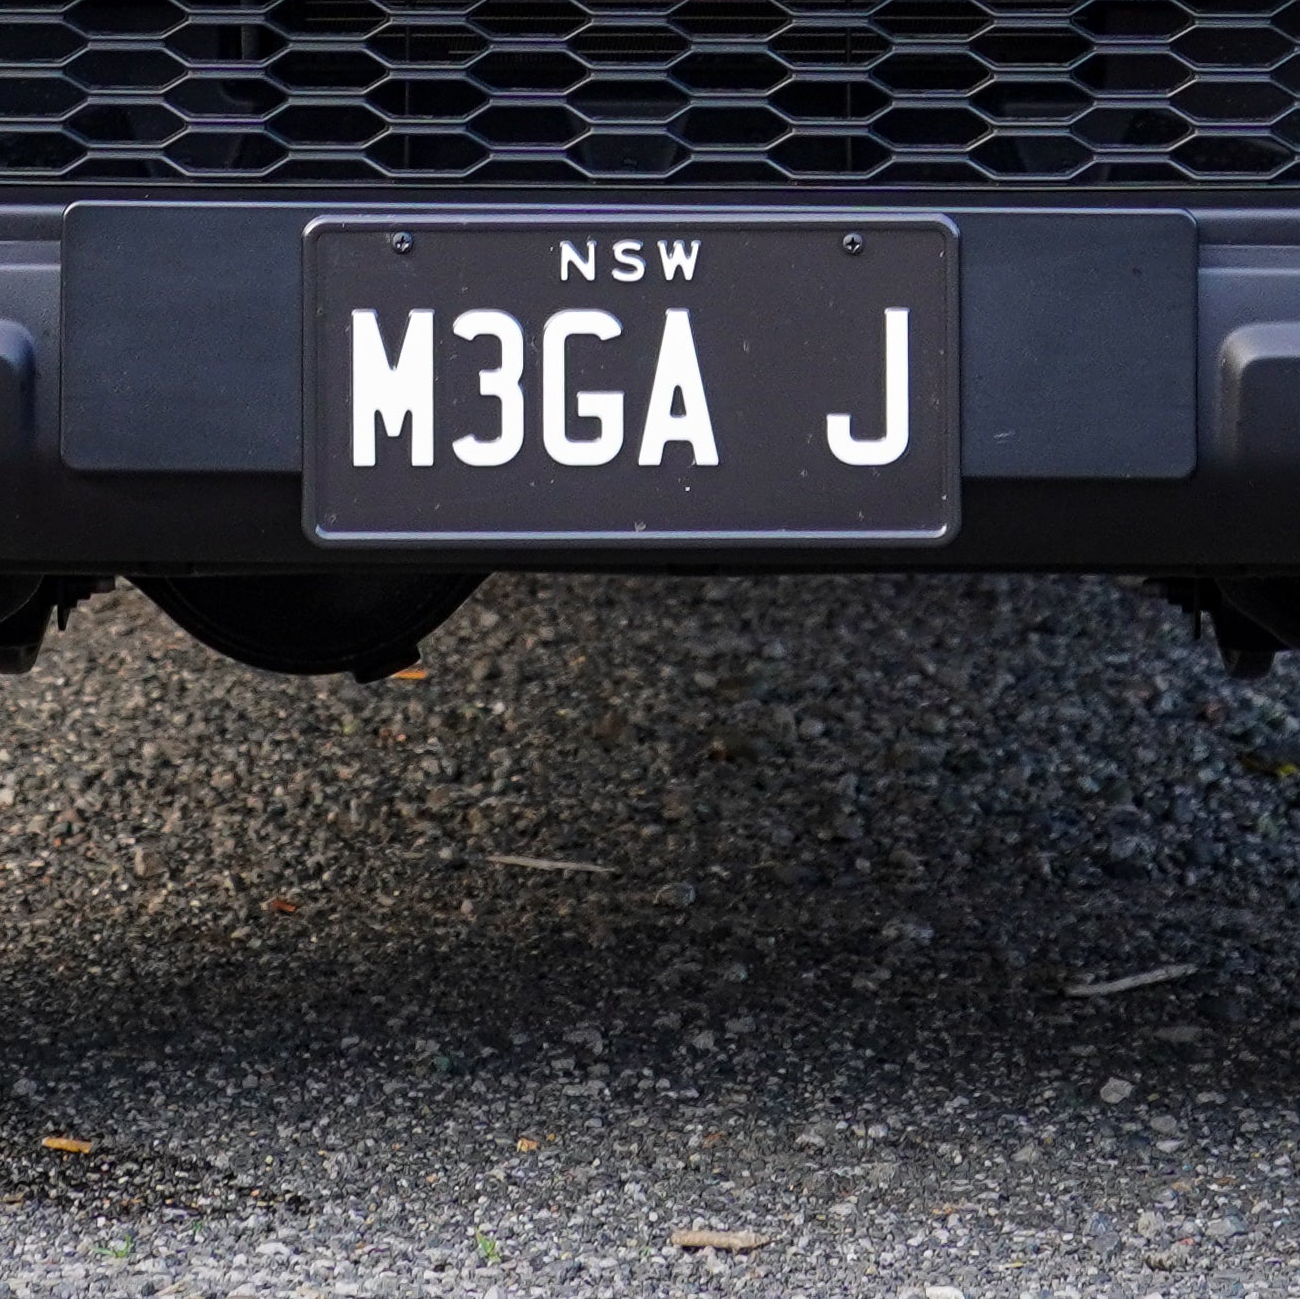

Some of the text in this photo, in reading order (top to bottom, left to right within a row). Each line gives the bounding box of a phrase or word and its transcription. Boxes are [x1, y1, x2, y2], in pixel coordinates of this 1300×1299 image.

[559, 238, 702, 283] NSW
[351, 307, 911, 467] M3GA J
